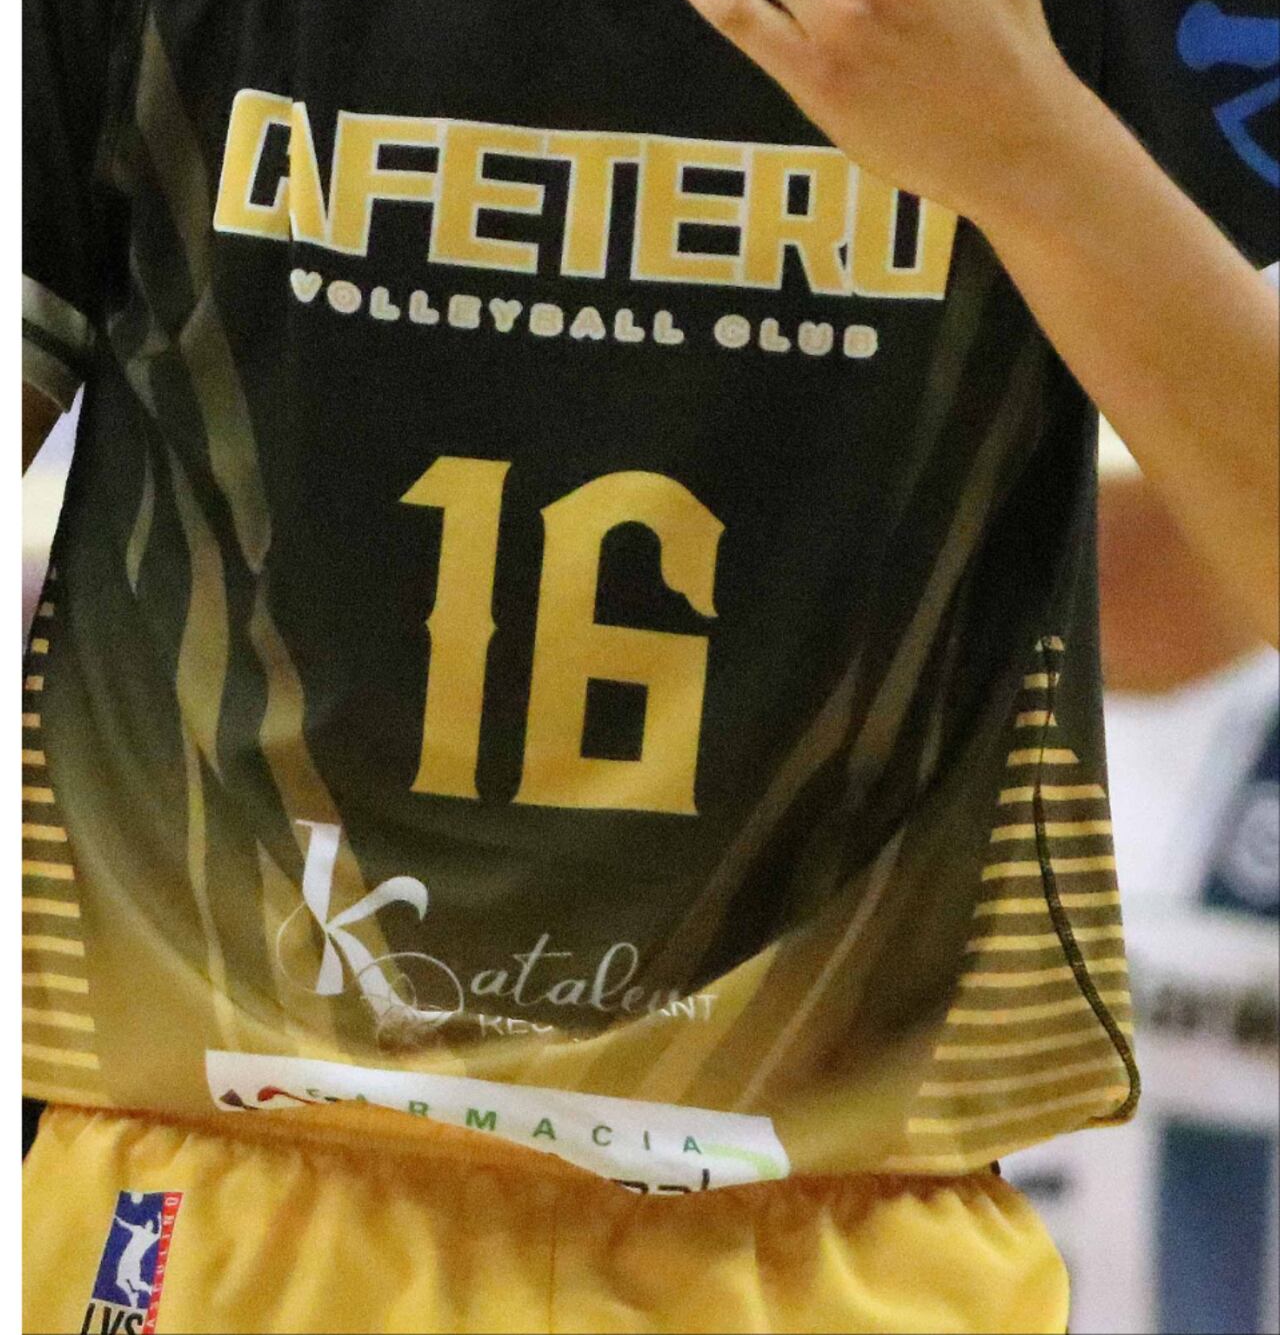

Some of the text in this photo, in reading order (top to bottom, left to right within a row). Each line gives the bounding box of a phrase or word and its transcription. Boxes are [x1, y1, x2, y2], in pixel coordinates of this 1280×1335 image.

[289, 268, 879, 359] VOLLEYBALL CLUB
[398, 455, 726, 816] 16
